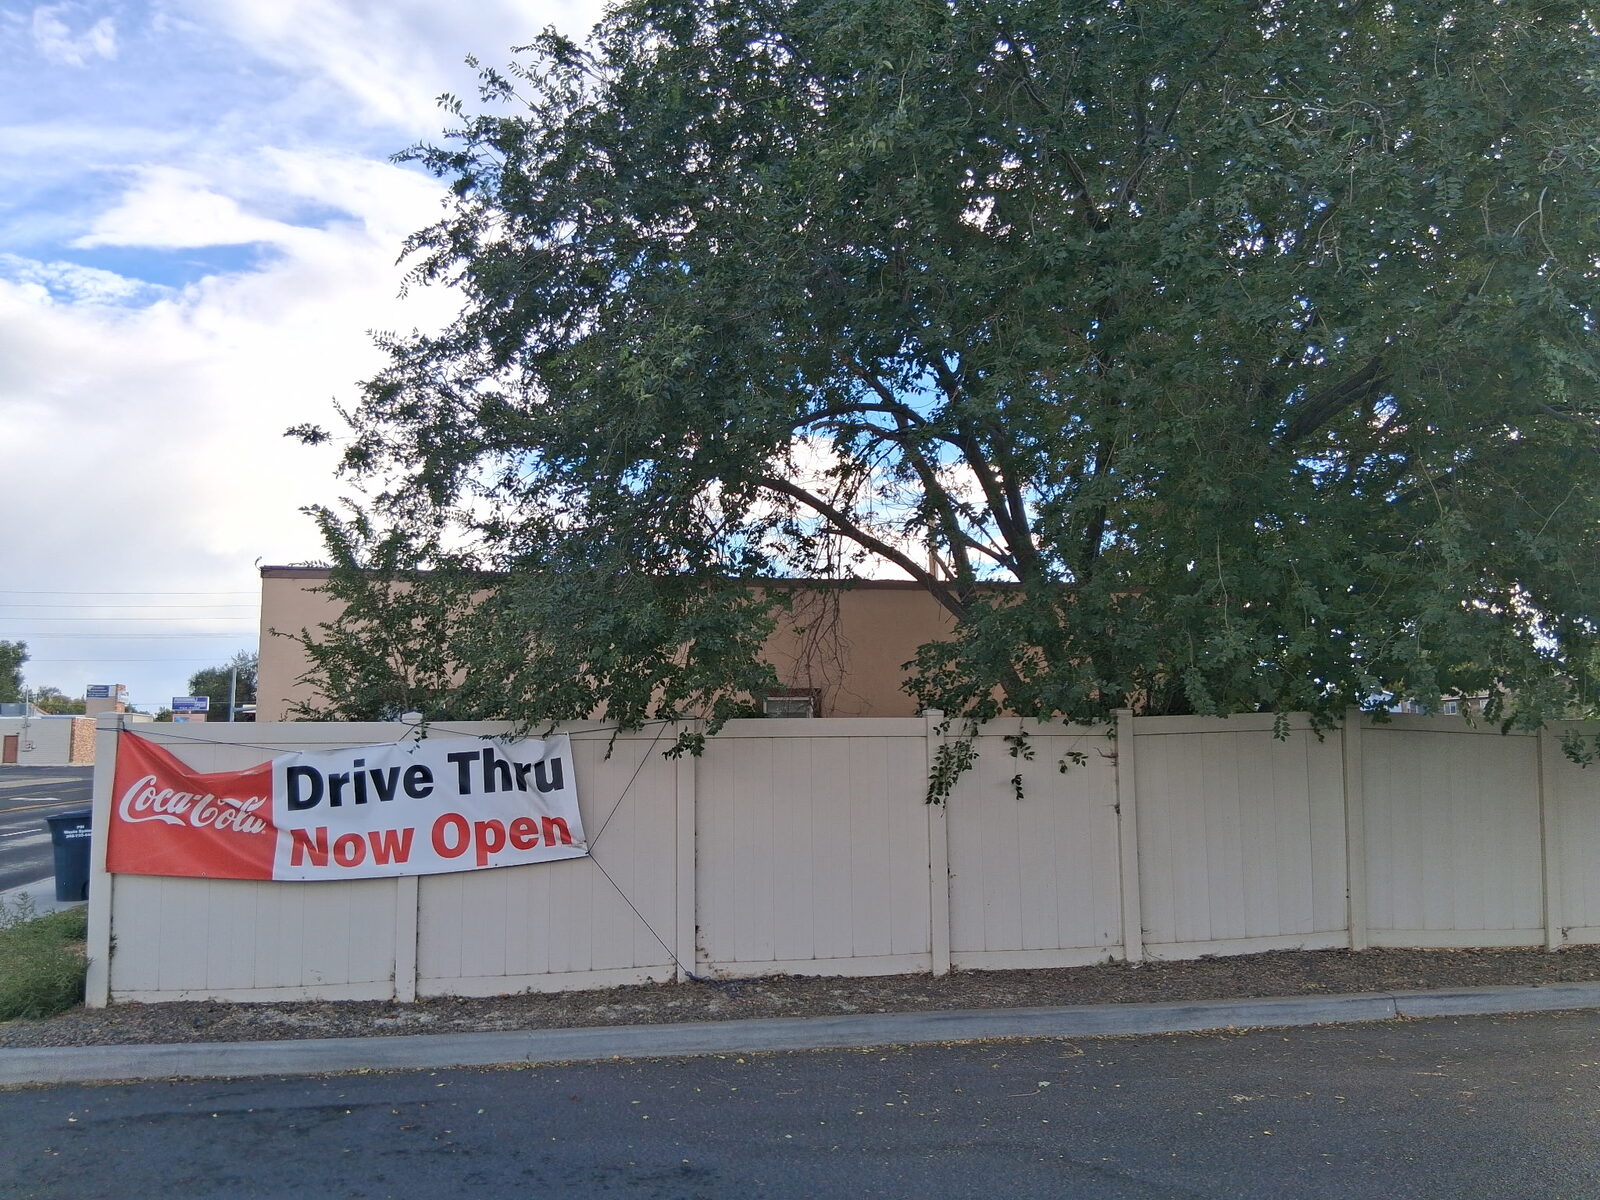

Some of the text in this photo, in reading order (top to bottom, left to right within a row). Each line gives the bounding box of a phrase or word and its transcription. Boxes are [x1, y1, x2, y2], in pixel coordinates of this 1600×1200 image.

[118, 774, 268, 835] Coca-Cola
[286, 747, 565, 811] Drive Thru
[290, 812, 572, 868] Now Open
